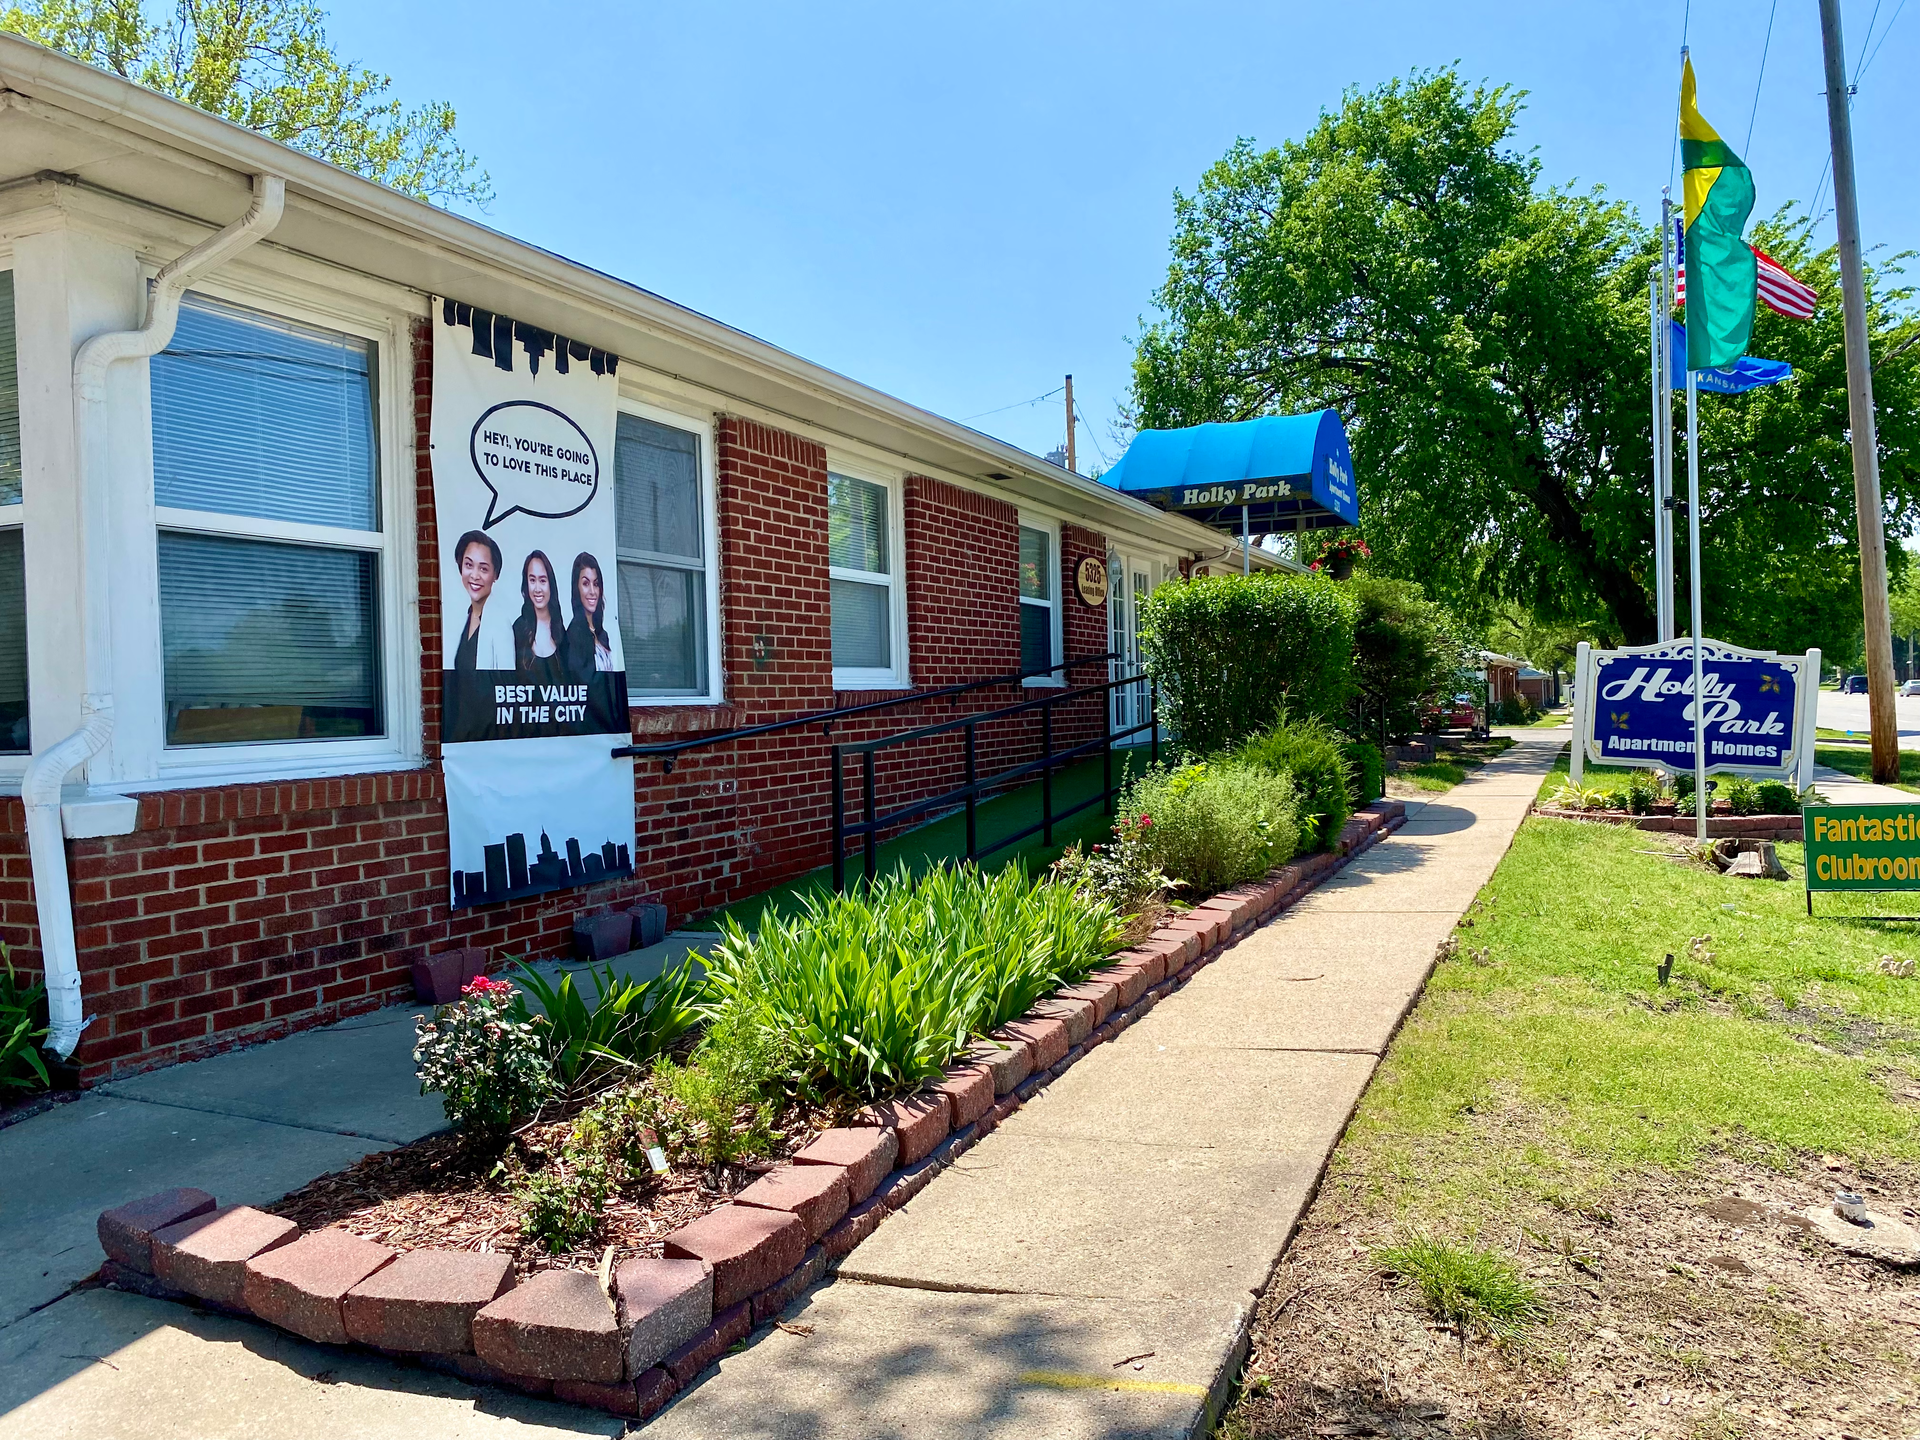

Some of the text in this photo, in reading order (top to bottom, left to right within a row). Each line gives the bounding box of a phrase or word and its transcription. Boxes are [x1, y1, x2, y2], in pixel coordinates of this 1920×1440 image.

[483, 430, 590, 466] HEY!, YOU'RE GOING
[483, 451, 593, 486] TO LOVE THIS PLACE
[1183, 480, 1291, 506] Holly Park
[1085, 561, 1102, 584] 5325
[494, 684, 588, 703] BEST VALUE
[1601, 667, 1737, 702] Holly
[496, 704, 587, 725] IN THE CITY
[1681, 697, 1785, 736] Park
[1608, 735, 1778, 758] Apartmen Homes
